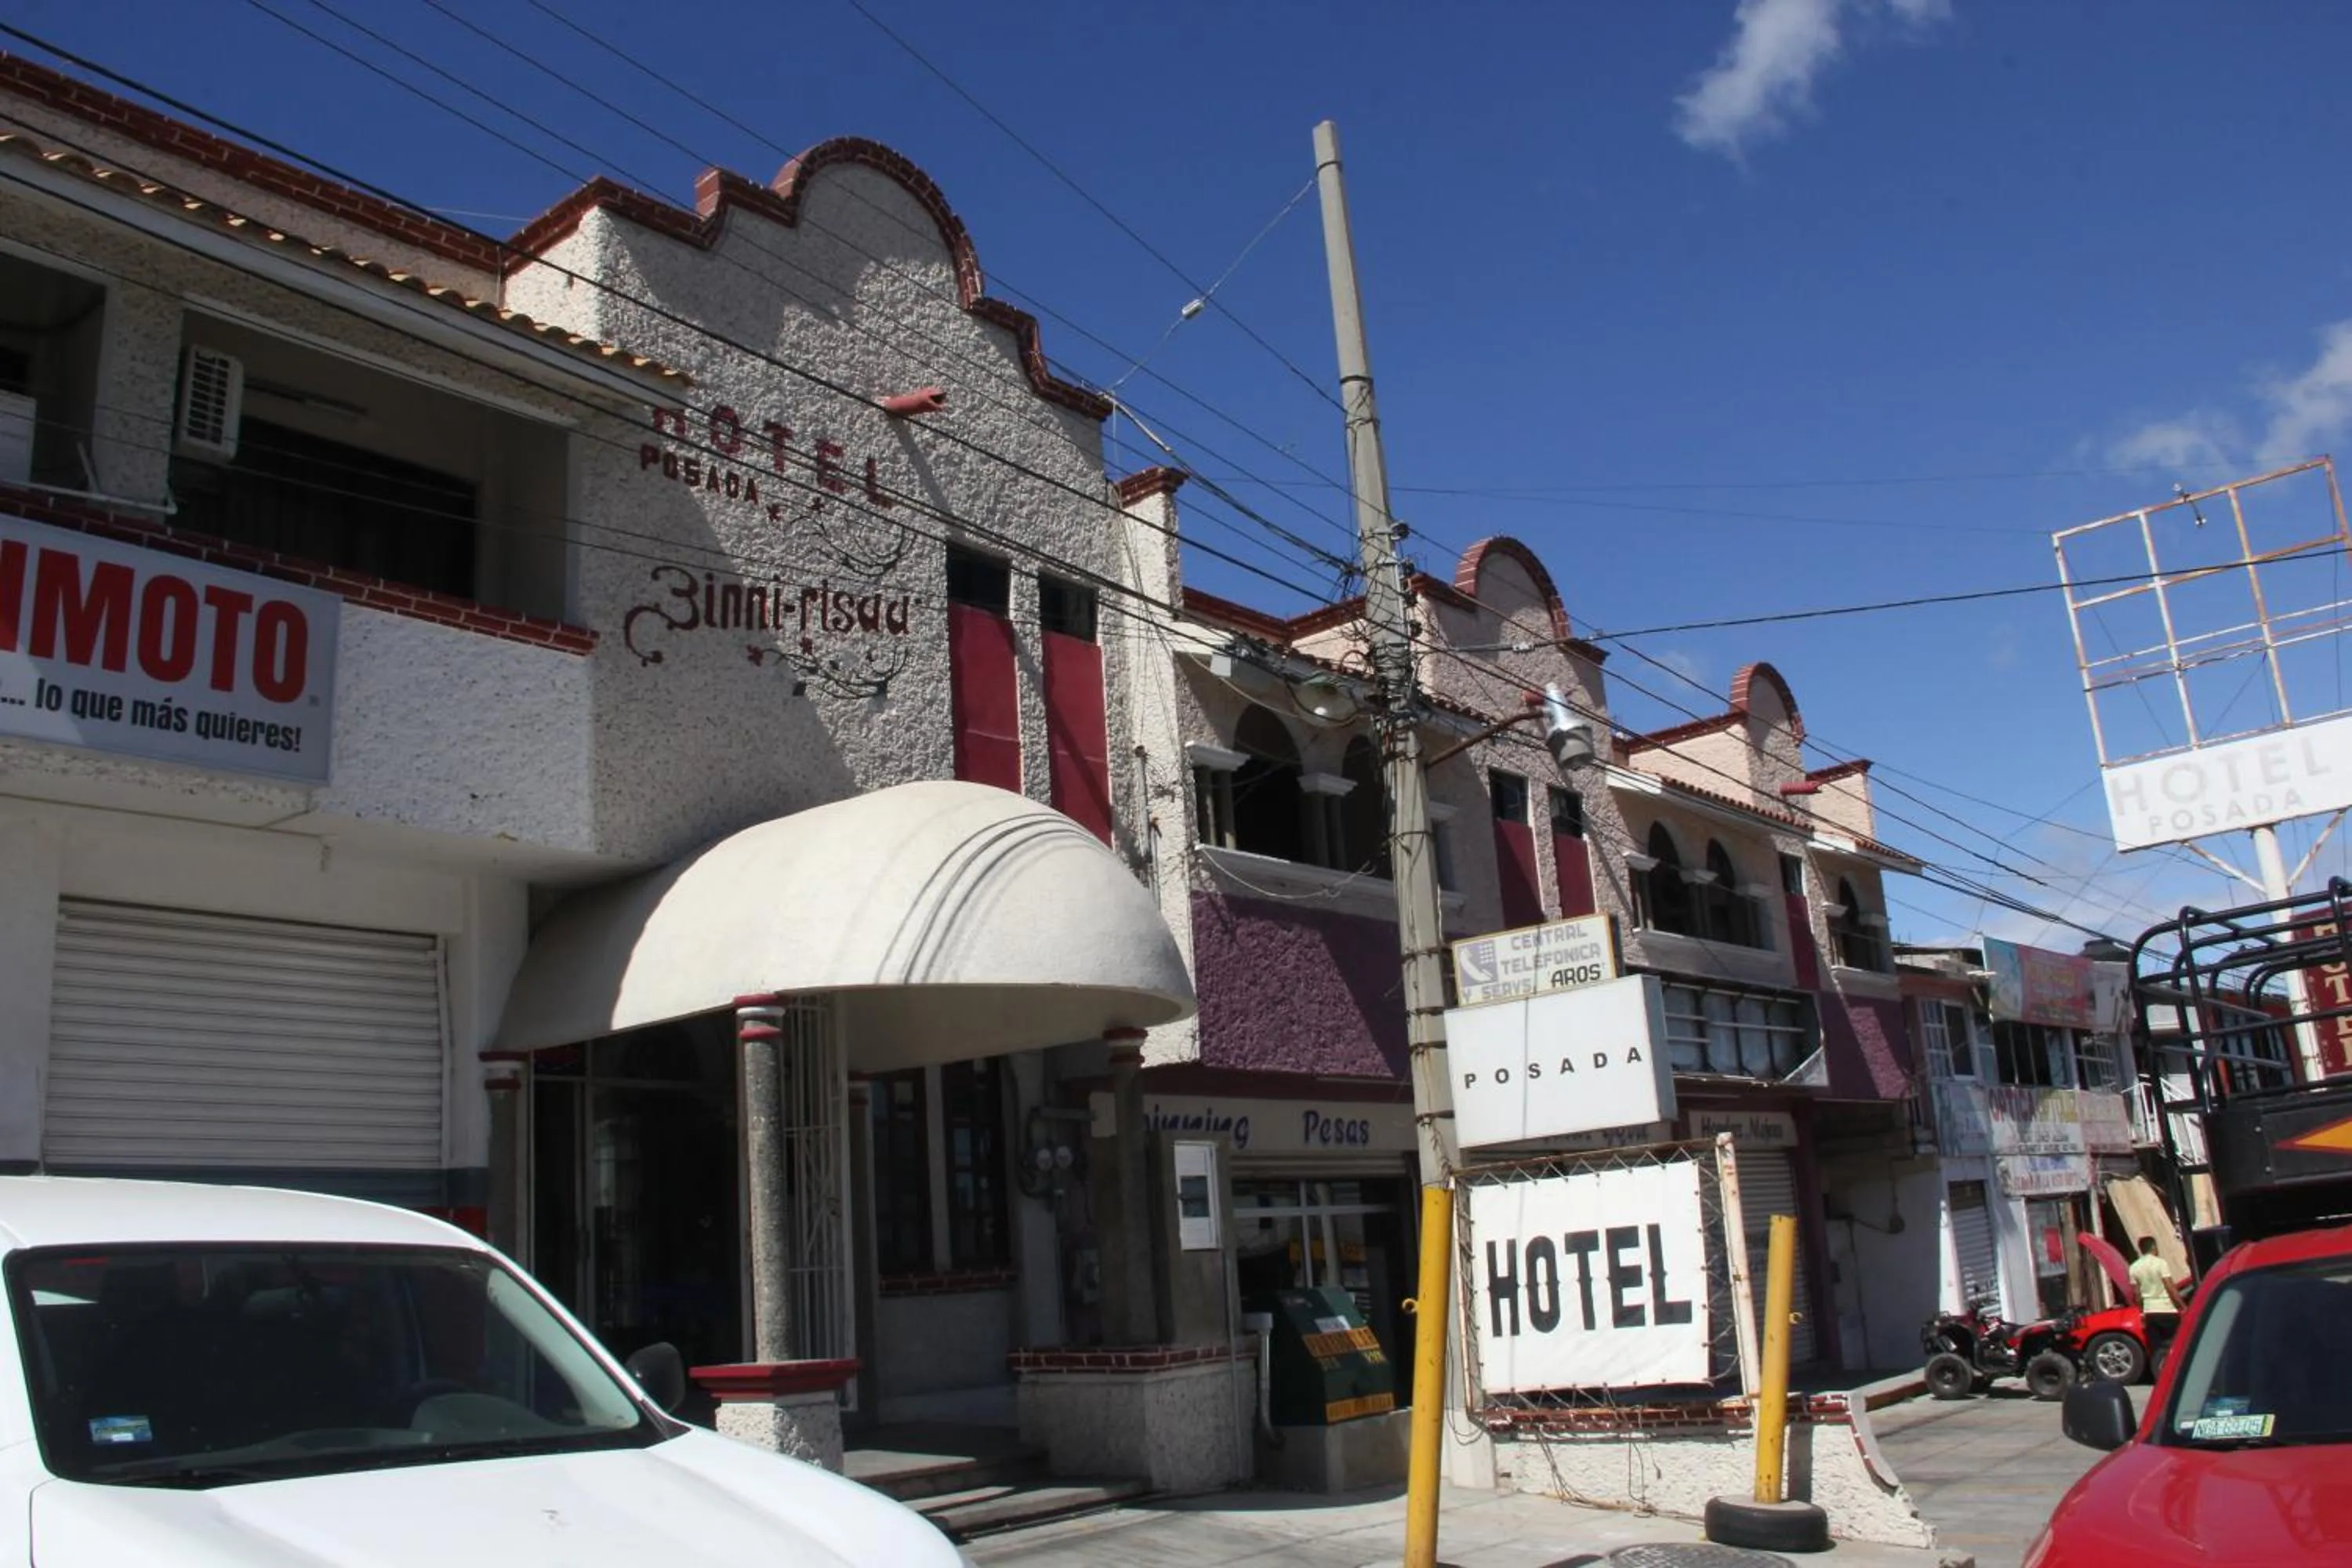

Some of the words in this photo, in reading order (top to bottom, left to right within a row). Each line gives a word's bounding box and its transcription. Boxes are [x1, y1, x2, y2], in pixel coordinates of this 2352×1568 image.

[639, 443, 760, 505] POSADA
[34, 677, 63, 710] lo
[71, 688, 123, 723] que
[130, 696, 189, 733] más
[195, 710, 303, 753] quieres!
[2109, 735, 2333, 816] HOTEL
[2148, 786, 2303, 837] POSADA
[1511, 923, 1588, 951] CENTRAL
[1463, 1046, 1643, 1090] POSADA
[1302, 1109, 1370, 1145] Pesas
[1486, 1223, 1693, 1338] HOTEL
